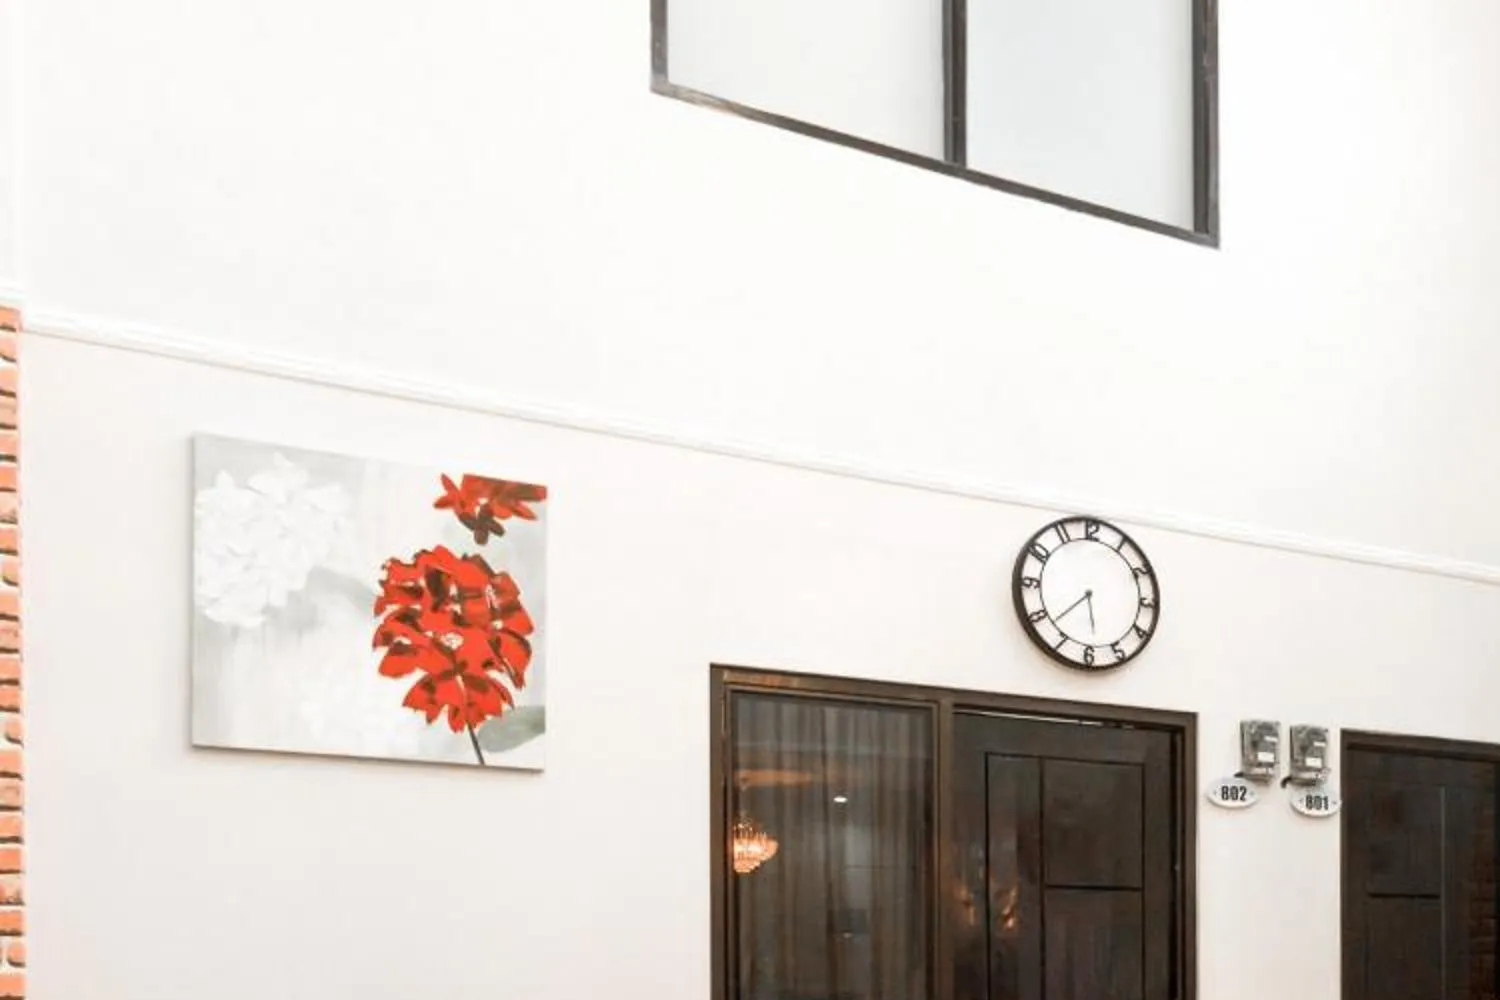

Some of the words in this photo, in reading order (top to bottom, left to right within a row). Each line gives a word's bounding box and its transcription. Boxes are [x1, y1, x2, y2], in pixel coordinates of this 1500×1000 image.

[1085, 520, 1100, 542] 12
[1028, 541, 1050, 564] 10
[1133, 563, 1150, 579] 2
[1021, 575, 1041, 589] 9
[1140, 596, 1156, 609] 3
[1028, 609, 1048, 623] 8
[1132, 622, 1150, 640] 4
[1083, 645, 1095, 666] 6
[1110, 640, 1126, 662] 5
[1220, 785, 1248, 801] 802
[1305, 794, 1329, 811] 801
